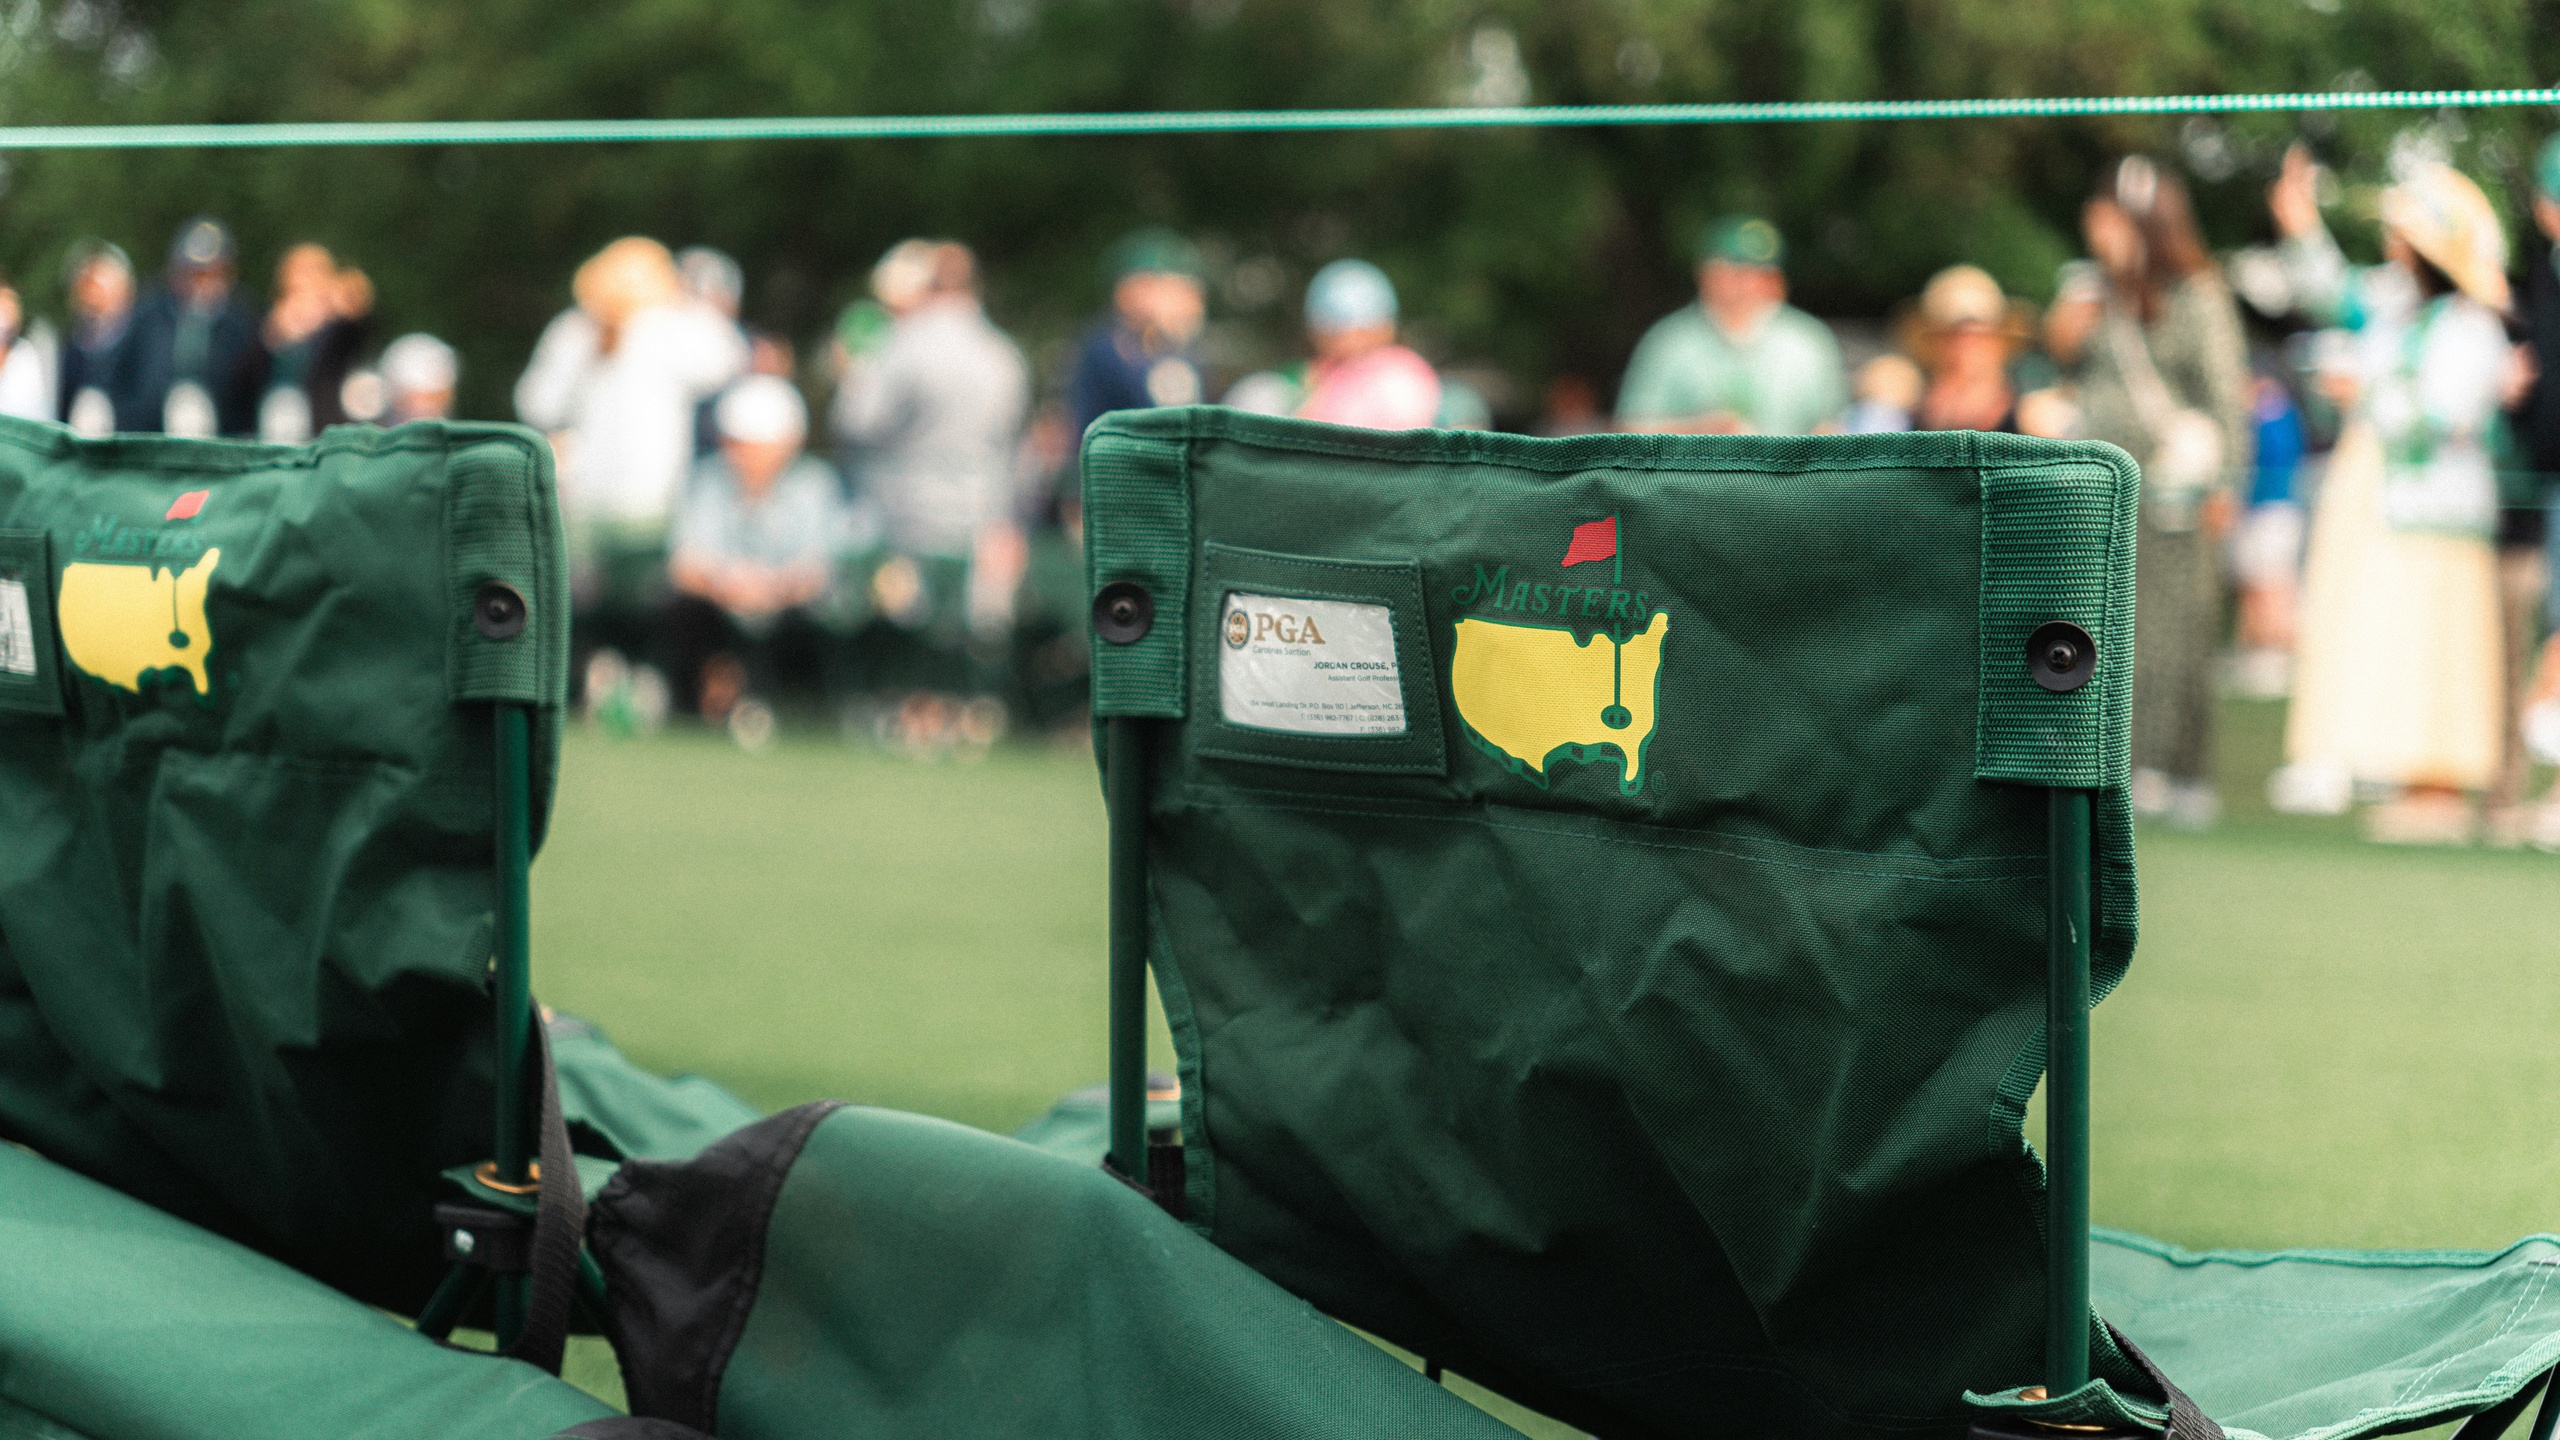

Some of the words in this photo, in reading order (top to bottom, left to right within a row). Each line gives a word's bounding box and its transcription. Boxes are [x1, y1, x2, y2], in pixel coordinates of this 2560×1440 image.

[1254, 612, 1326, 645] PGA
[1253, 645, 1283, 655] Carolinas
[1284, 647, 1311, 656] Section
[1314, 661, 1348, 670] JORDAN
[1350, 662, 1389, 671] CROUSE,
[1321, 702, 1334, 710] Box
